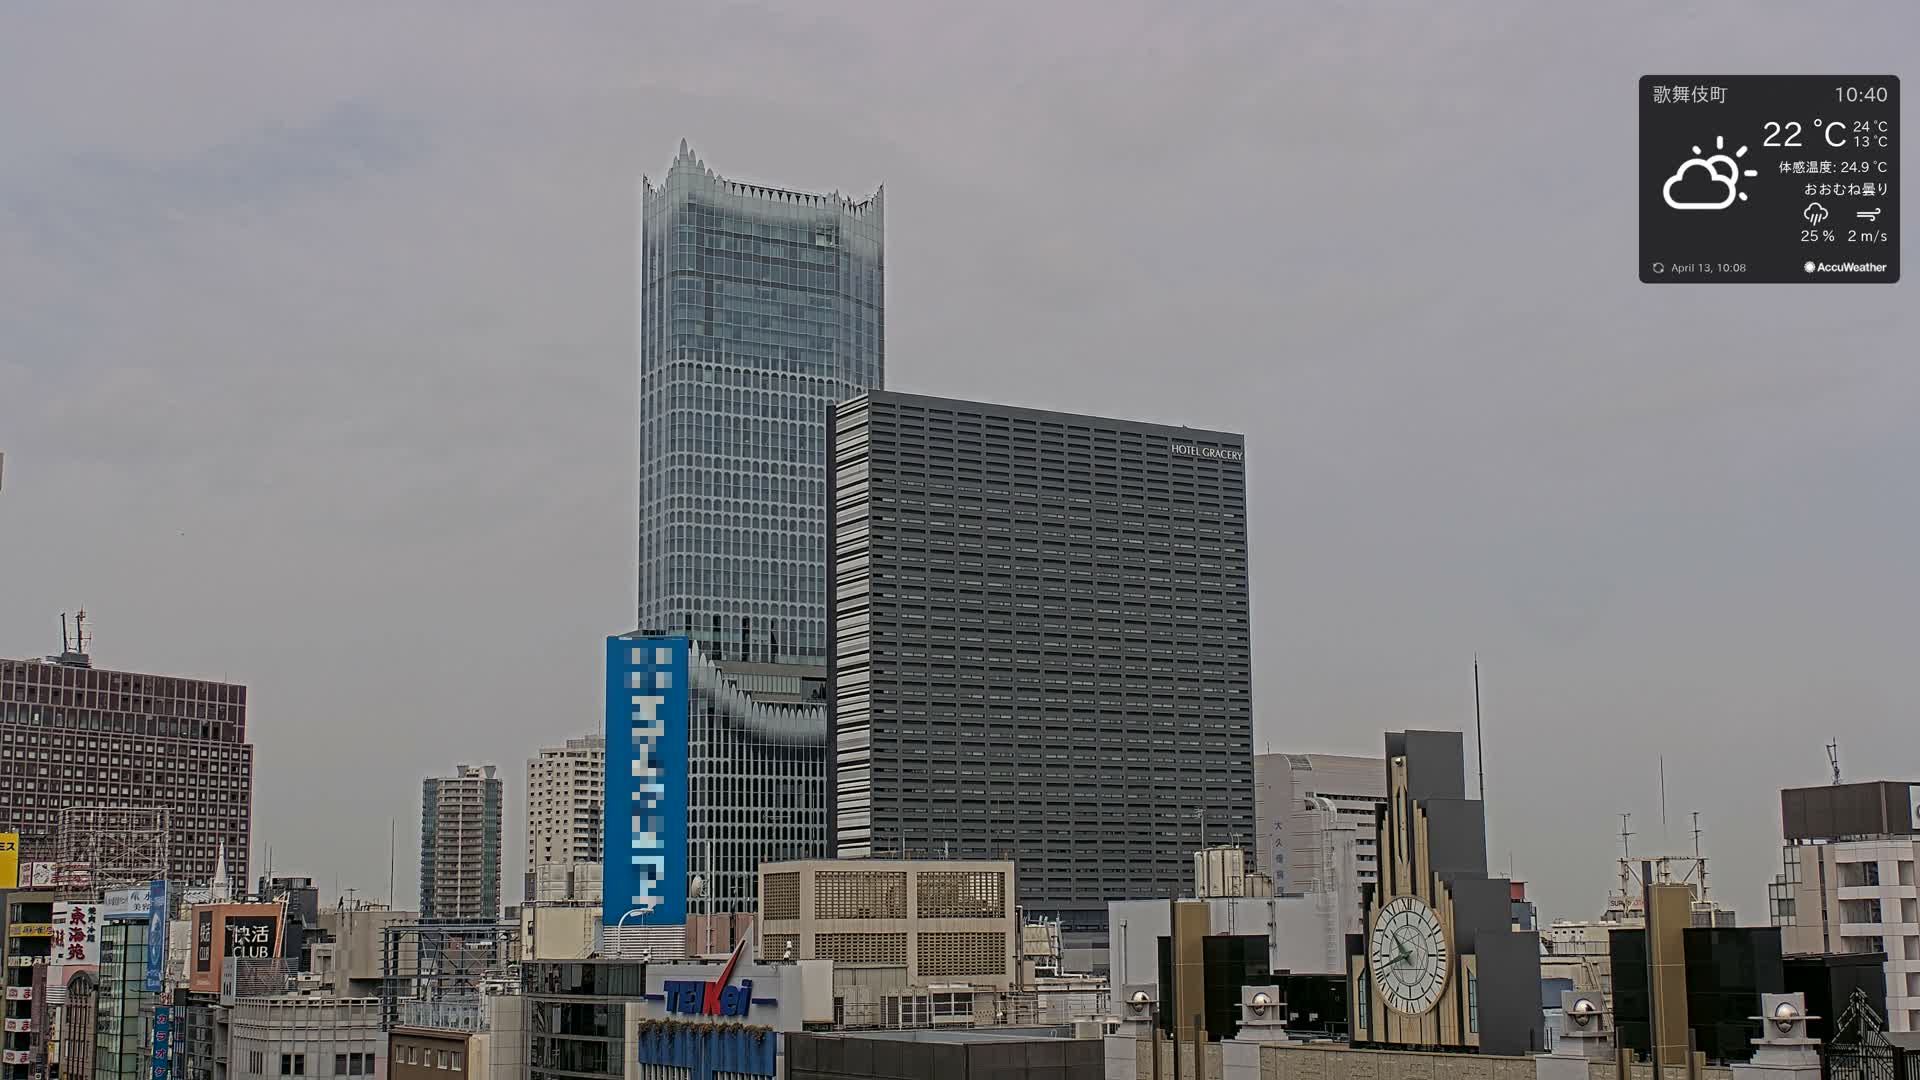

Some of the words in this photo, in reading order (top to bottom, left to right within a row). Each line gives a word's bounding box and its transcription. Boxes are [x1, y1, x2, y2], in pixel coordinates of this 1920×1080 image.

[1171, 444, 1200, 456] HOTEL
[1202, 447, 1243, 461] GRACERY
[66, 906, 86, 960] 東海苑
[234, 925, 269, 943] 快活
[233, 946, 268, 958] CLUB
